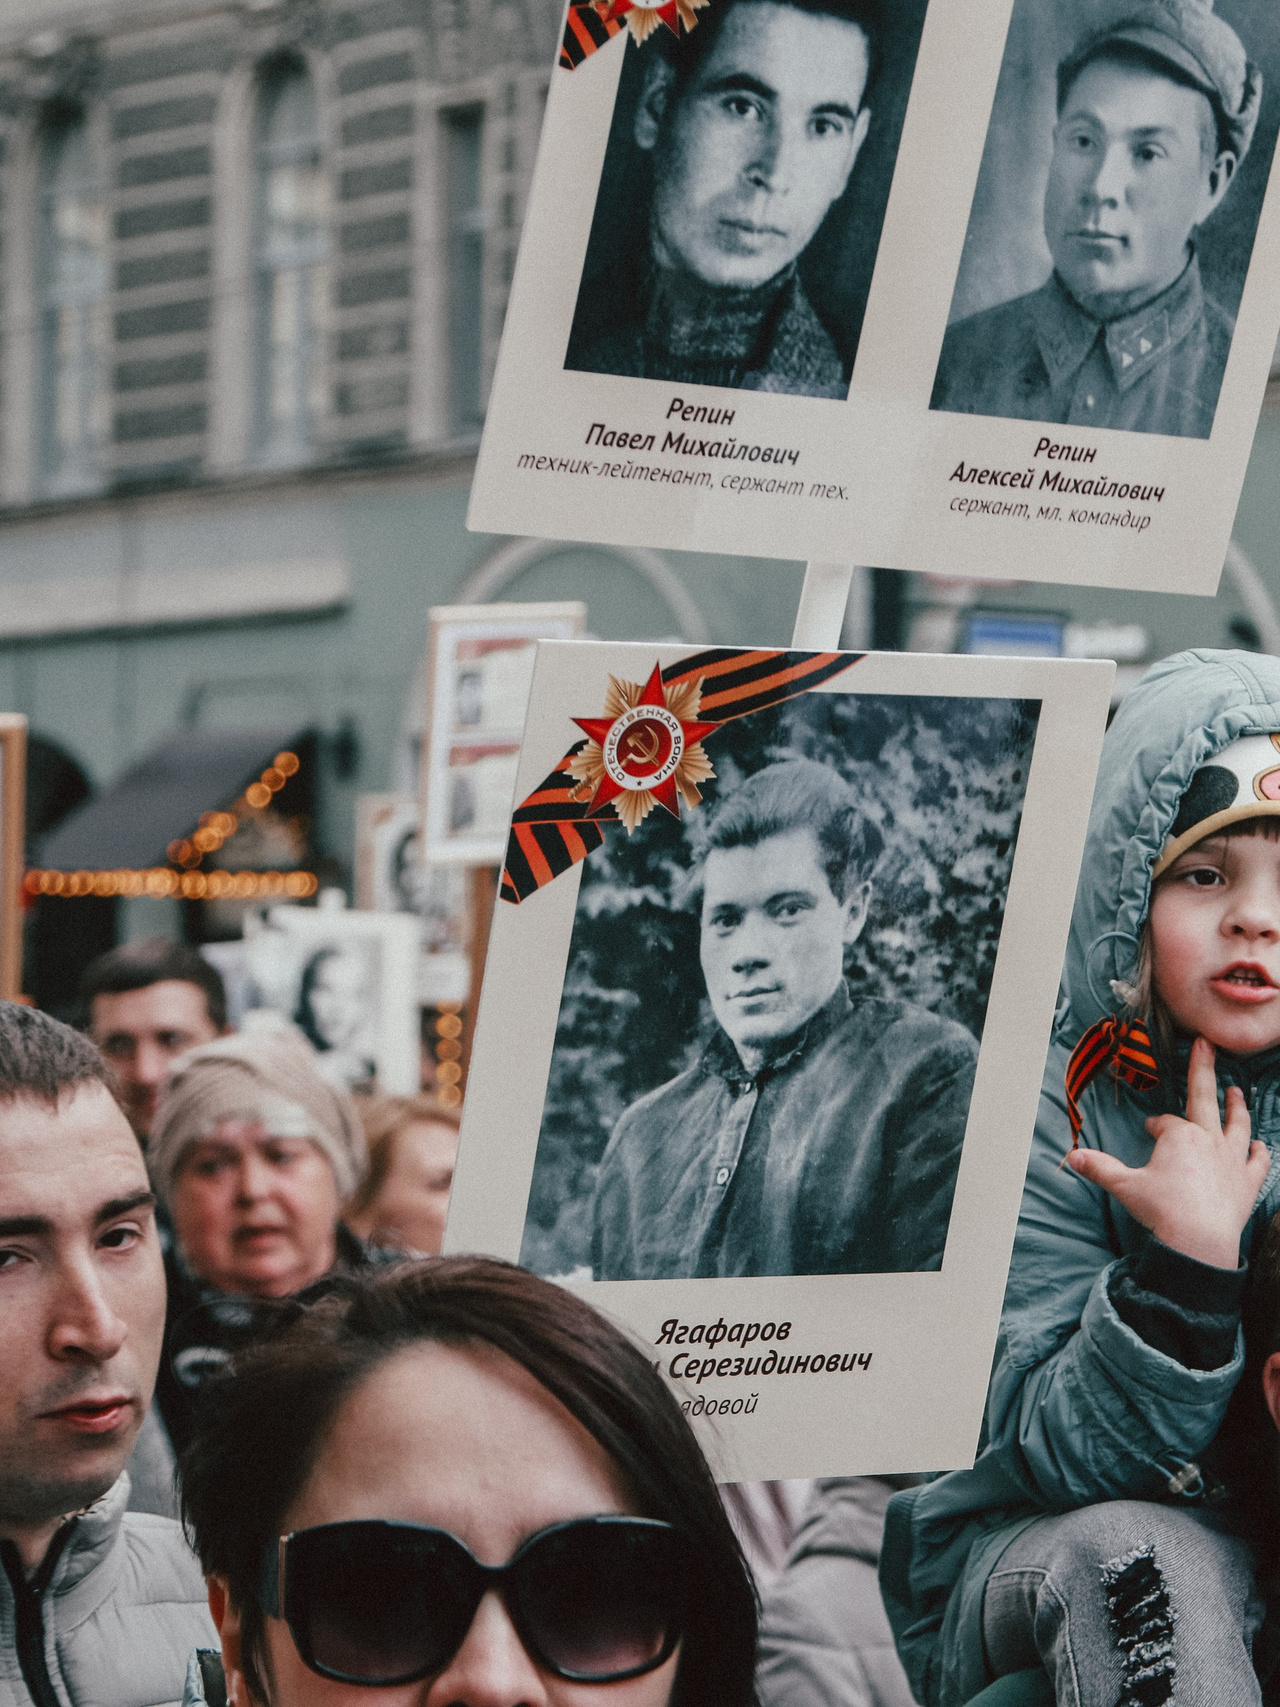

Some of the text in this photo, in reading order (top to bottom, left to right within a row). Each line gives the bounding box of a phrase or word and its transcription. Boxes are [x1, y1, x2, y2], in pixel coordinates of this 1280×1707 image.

[665, 397, 736, 426] Репин
[584, 422, 801, 466] Павел Михайлович
[1032, 436, 1098, 464] Репин
[516, 453, 849, 501] техник-лейтенант, сержант тех.
[948, 460, 1166, 503] Алексей Михайлович
[949, 496, 1152, 534] сержант, мл. командир
[606, 708, 679, 781] ОТЕЧЕСТВЕННАЯ
[654, 1317, 793, 1350] Ягафаров
[668, 1349, 874, 1385] Серезидинович
[681, 1392, 760, 1418] ядовой
